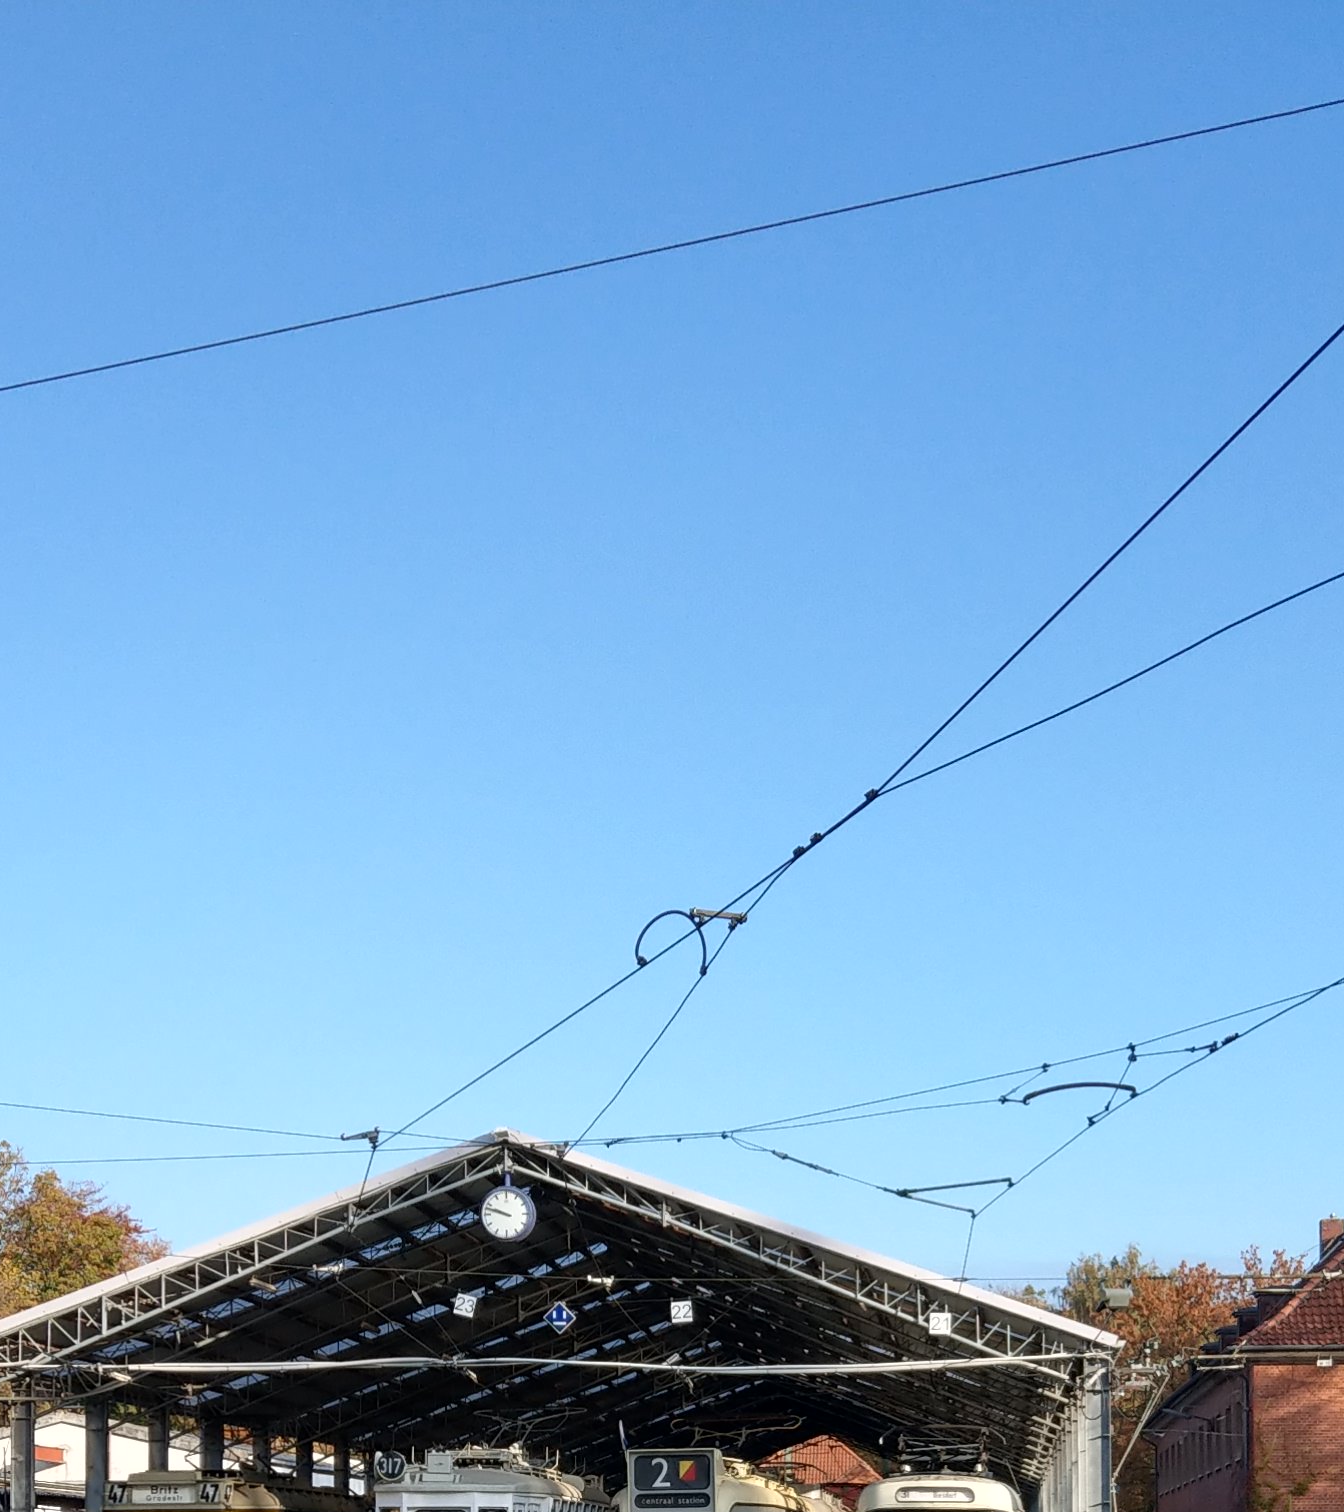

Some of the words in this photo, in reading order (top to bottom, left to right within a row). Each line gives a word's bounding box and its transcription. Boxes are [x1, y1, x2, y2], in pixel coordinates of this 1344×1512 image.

[455, 1296, 474, 1314] 23
[672, 1305, 692, 1319] 22
[931, 1316, 949, 1331] 21
[380, 1457, 402, 1474] 317
[651, 1457, 671, 1488] 2
[108, 1484, 127, 1503] 47
[150, 1484, 180, 1495] Britz
[200, 1483, 220, 1503] 47
[641, 1497, 674, 1505] centraal
[678, 1497, 705, 1505] station
